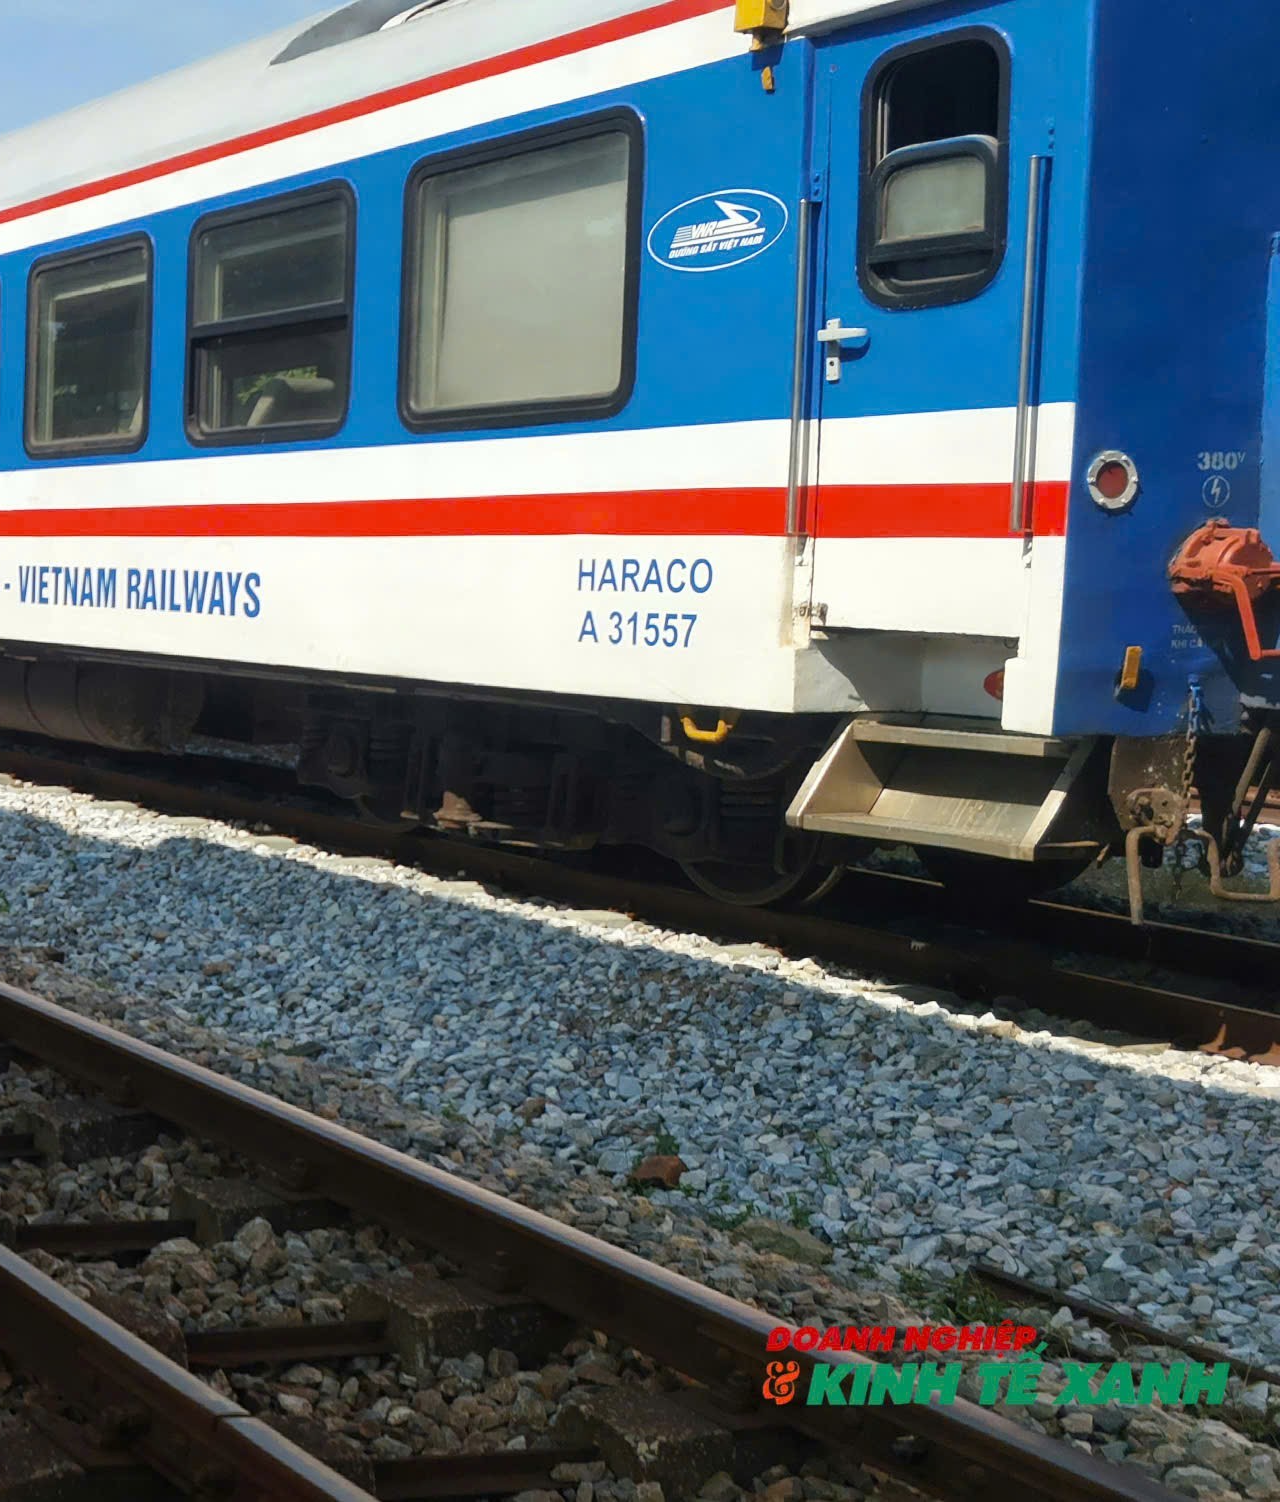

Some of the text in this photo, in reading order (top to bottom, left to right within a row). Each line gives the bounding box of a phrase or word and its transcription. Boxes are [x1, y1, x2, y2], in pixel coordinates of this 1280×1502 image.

[691, 221, 716, 239] VNR
[740, 235, 764, 247] NAM
[19, 564, 118, 609] VIETNAM
[126, 568, 262, 619] RAILWAYS
[577, 557, 714, 594] HARACO
[577, 609, 698, 649] A 31557
